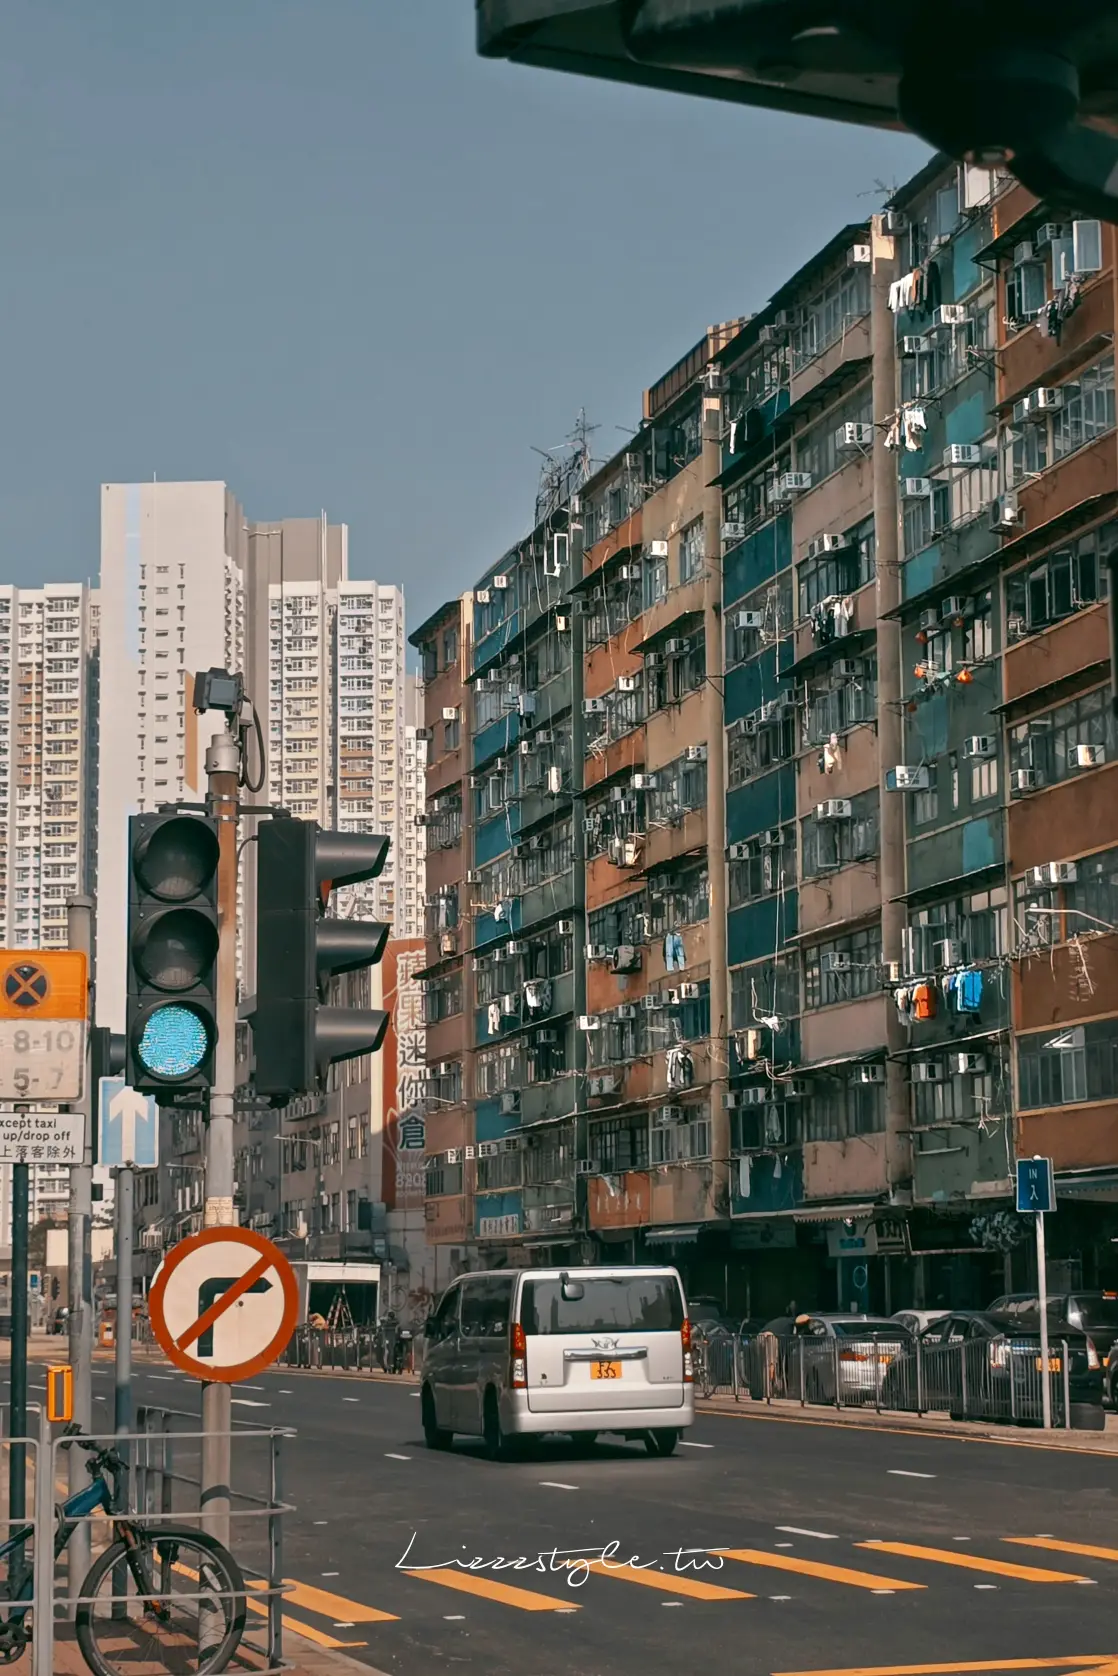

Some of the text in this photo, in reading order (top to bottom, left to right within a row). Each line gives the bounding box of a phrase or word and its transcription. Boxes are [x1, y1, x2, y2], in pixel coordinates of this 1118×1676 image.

[13, 1029, 75, 1053] 8-10
[35, 1118, 57, 1129] taxi
[3, 1130, 72, 1142] up/drop off
[1028, 1168, 1038, 1180] IN
[1029, 1185, 1039, 1201] 入
